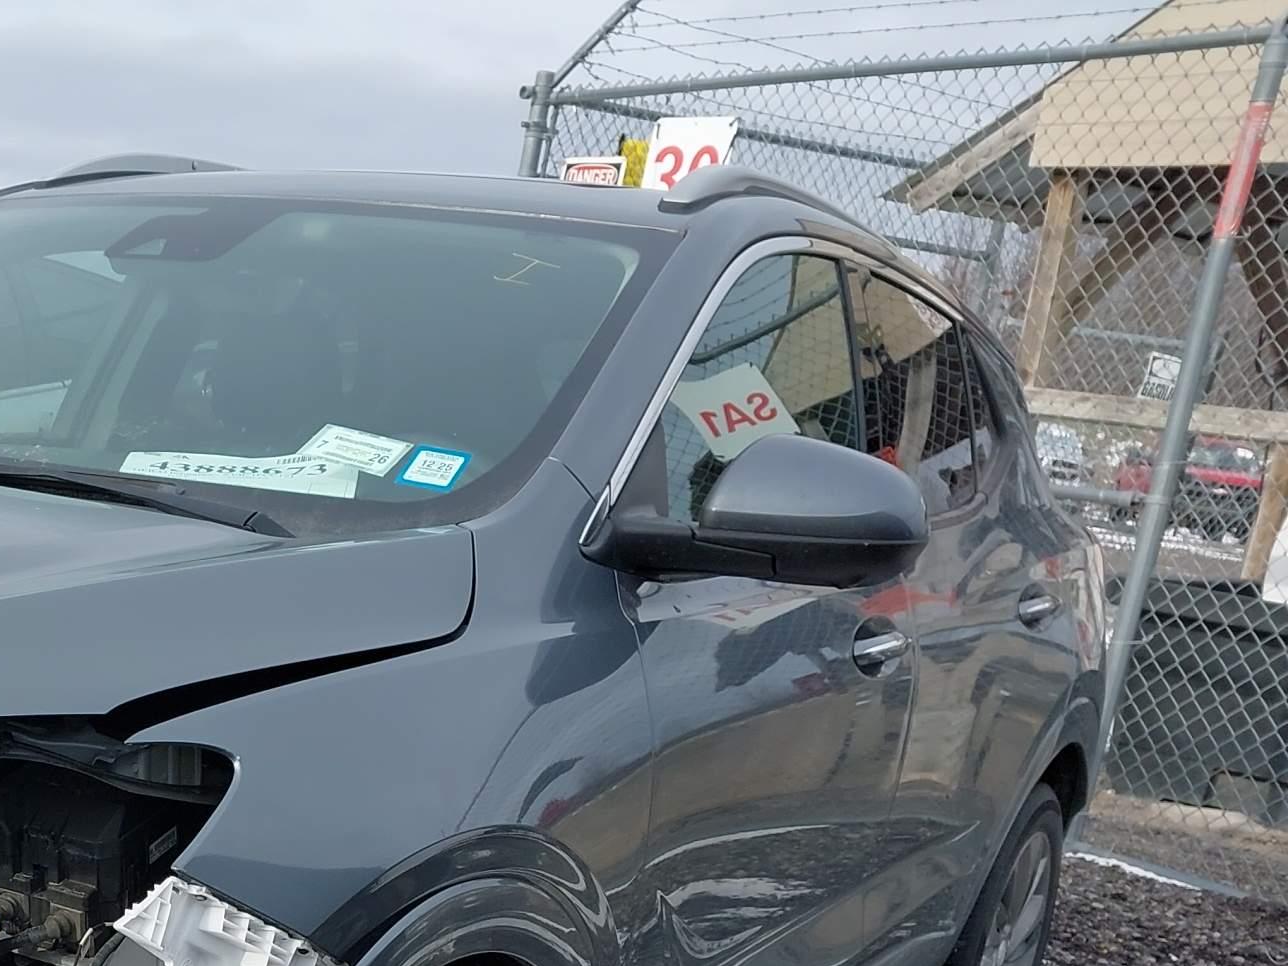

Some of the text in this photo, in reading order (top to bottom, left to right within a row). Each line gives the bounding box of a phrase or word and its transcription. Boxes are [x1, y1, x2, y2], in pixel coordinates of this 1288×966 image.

[567, 167, 616, 184] DANGER
[368, 452, 390, 465] 26
[150, 460, 328, 478] 43888673
[439, 461, 453, 472] 25
